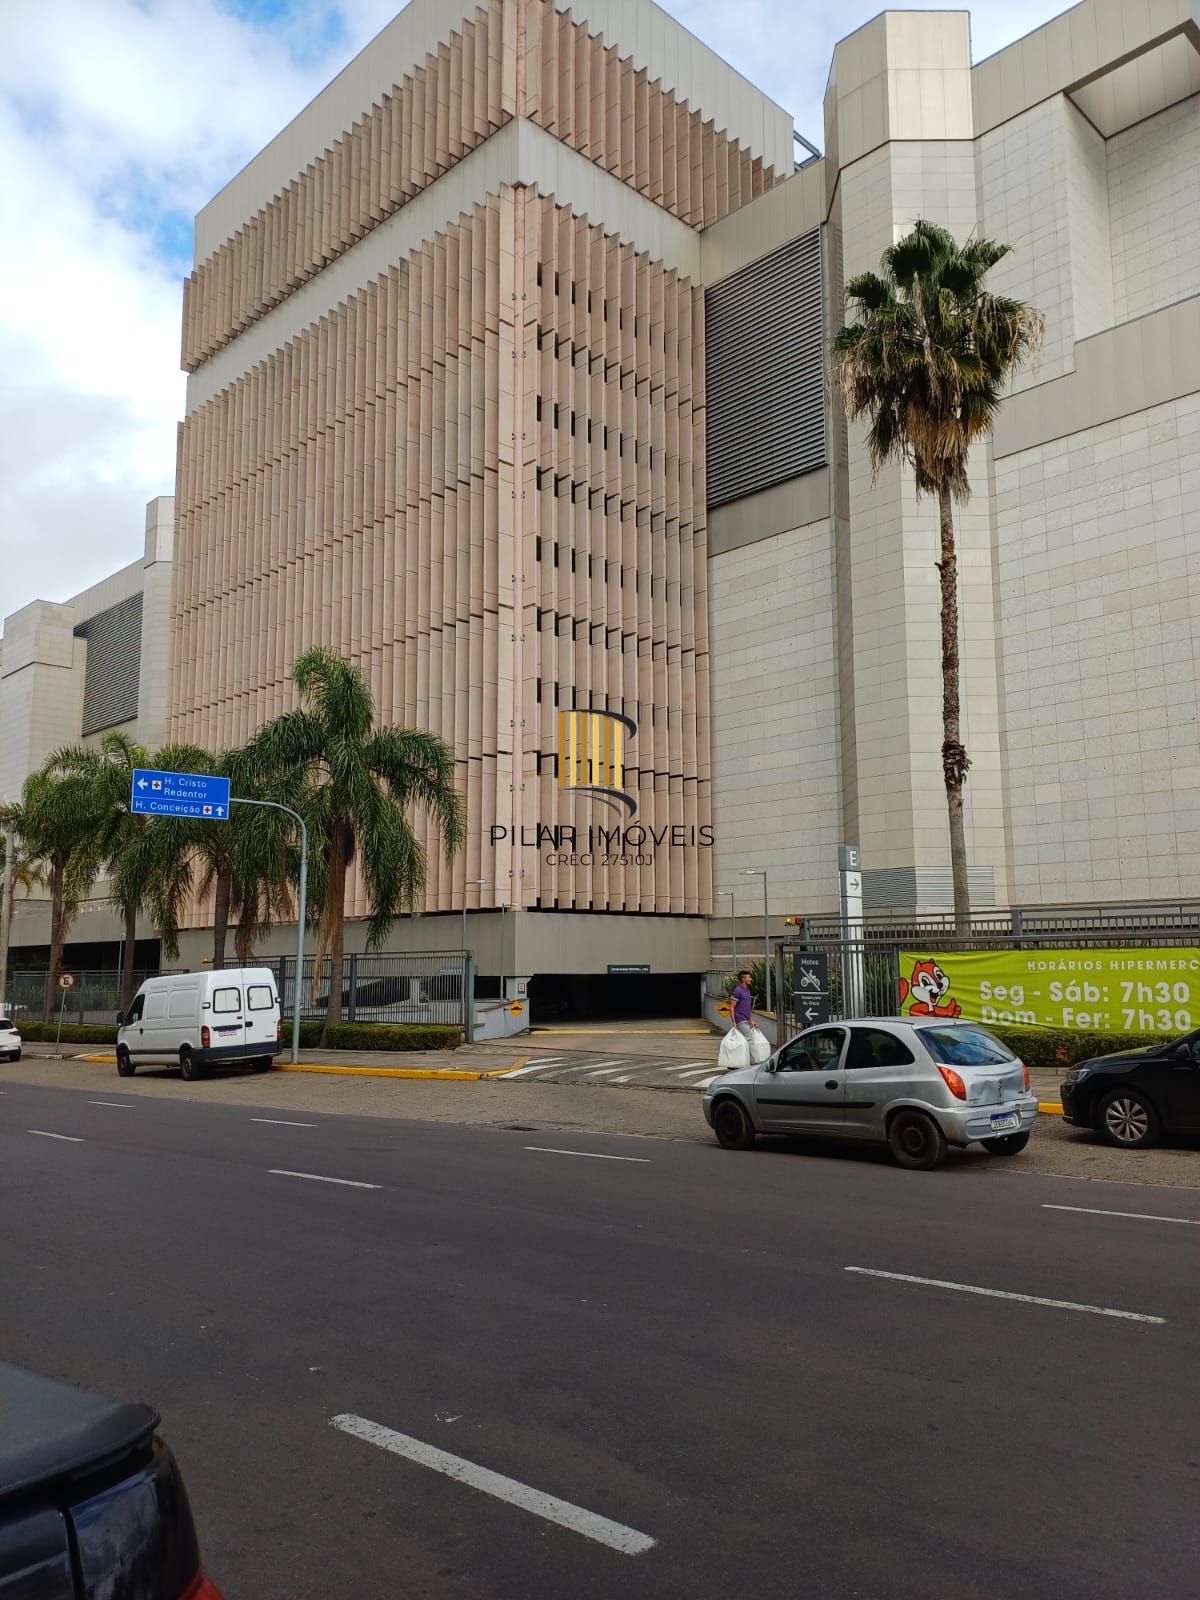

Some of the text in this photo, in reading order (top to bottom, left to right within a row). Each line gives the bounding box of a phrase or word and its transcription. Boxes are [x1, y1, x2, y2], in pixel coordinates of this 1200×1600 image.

[164, 777, 207, 788] H. Cristo
[164, 788, 207, 799] Redentor
[135, 801, 201, 814] H. Conceição
[849, 850, 857, 866] E
[1027, 958, 1103, 971] HORÁRIOS
[979, 980, 1025, 1007] Seg
[1050, 979, 1109, 1003] Sáb:
[1120, 981, 1190, 1003] 7h30
[982, 1006, 1036, 1025] Dom
[1062, 1007, 1111, 1028] Fer:
[1121, 1008, 1192, 1031] 7h30
